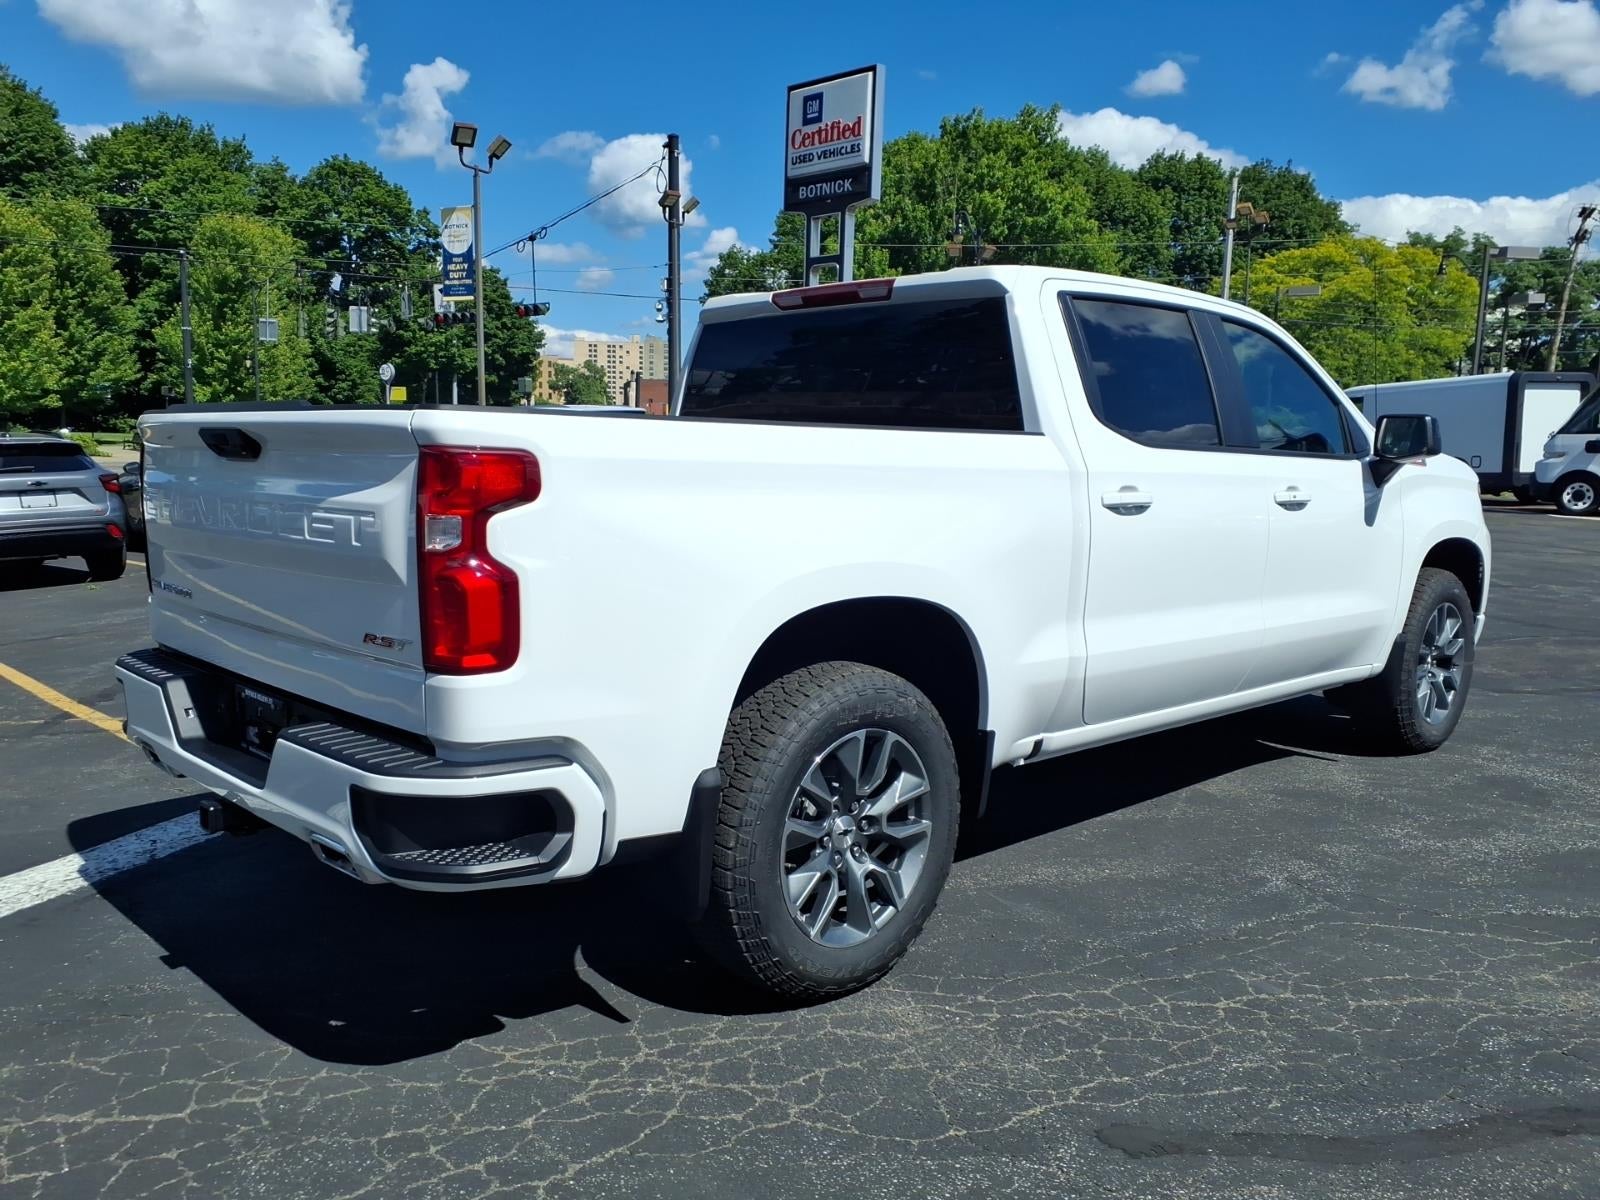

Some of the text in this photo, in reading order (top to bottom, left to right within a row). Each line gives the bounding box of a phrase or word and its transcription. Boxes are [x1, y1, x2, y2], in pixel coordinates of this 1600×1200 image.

[806, 98, 820, 114] GM
[791, 115, 862, 150] Certified
[791, 143, 861, 166] USED VEHICLES
[799, 178, 853, 199] BOTNICK
[447, 263, 469, 271] HEAVY
[449, 271, 467, 279] DUTY
[363, 632, 413, 651] RST
